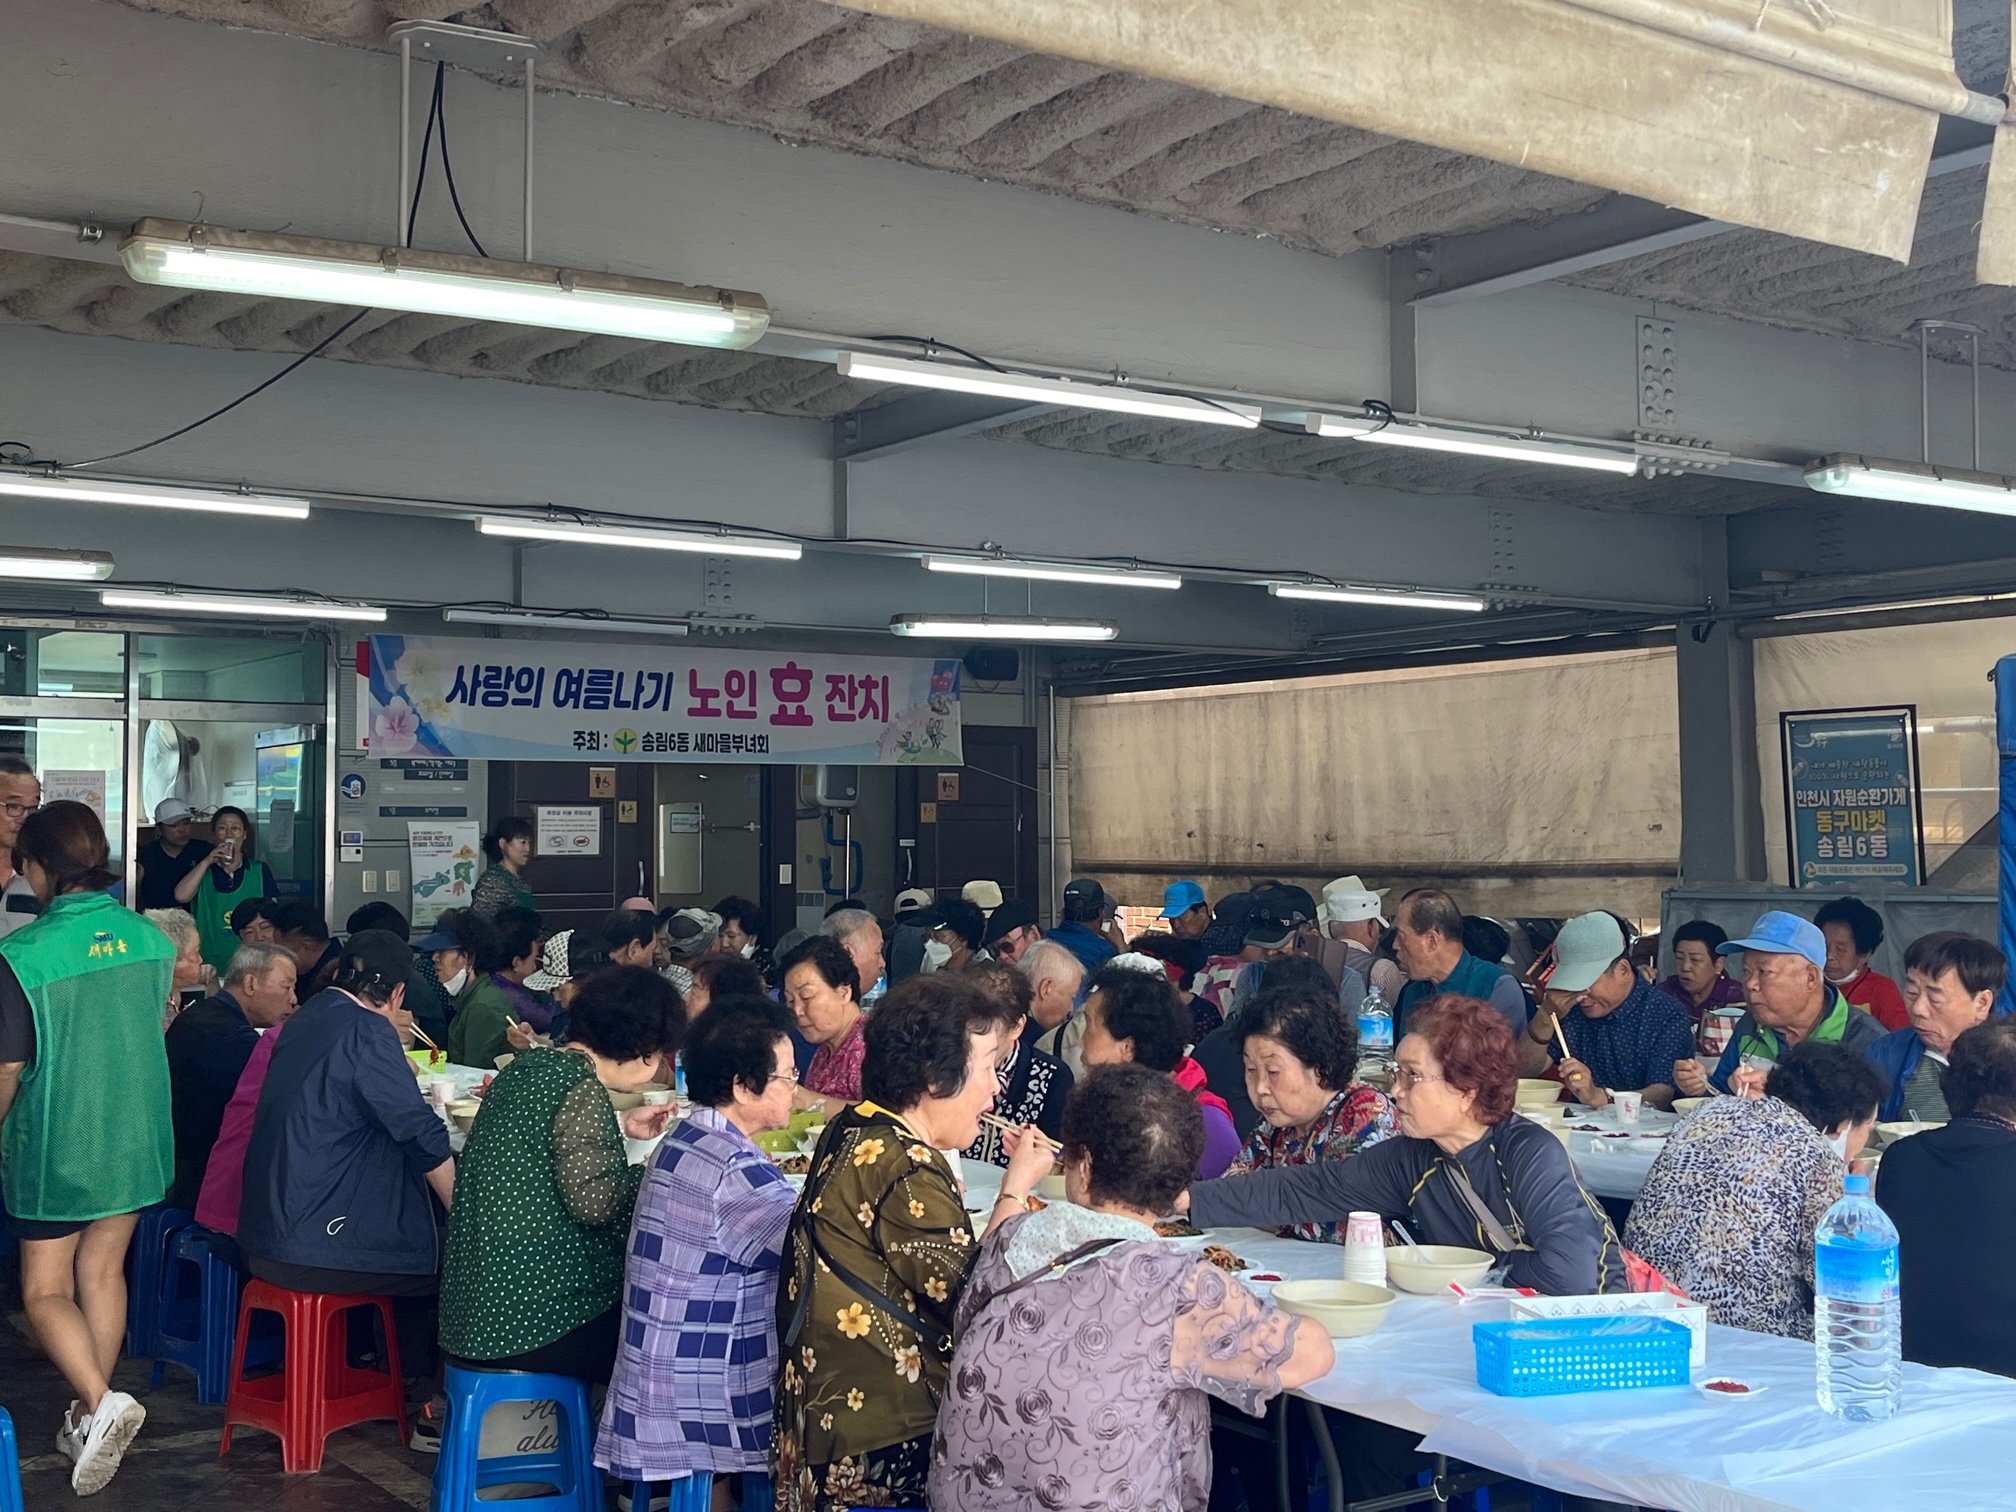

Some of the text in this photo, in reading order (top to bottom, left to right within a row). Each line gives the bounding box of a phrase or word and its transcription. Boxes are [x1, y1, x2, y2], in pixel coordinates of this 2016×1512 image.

[445, 661, 891, 727] 사랑의 여름나기 노인 효 잔치
[572, 729, 601, 752] 주최
[641, 731, 690, 754] 송림6동
[693, 731, 770, 755] 새마을부녀회
[1808, 773, 1829, 781] 100%
[1796, 787, 1907, 807] 인천시 자원순환가게
[1816, 809, 1887, 833] 동구마켓
[1817, 834, 1889, 859] 송림6동
[88, 938, 128, 959] 새마을
